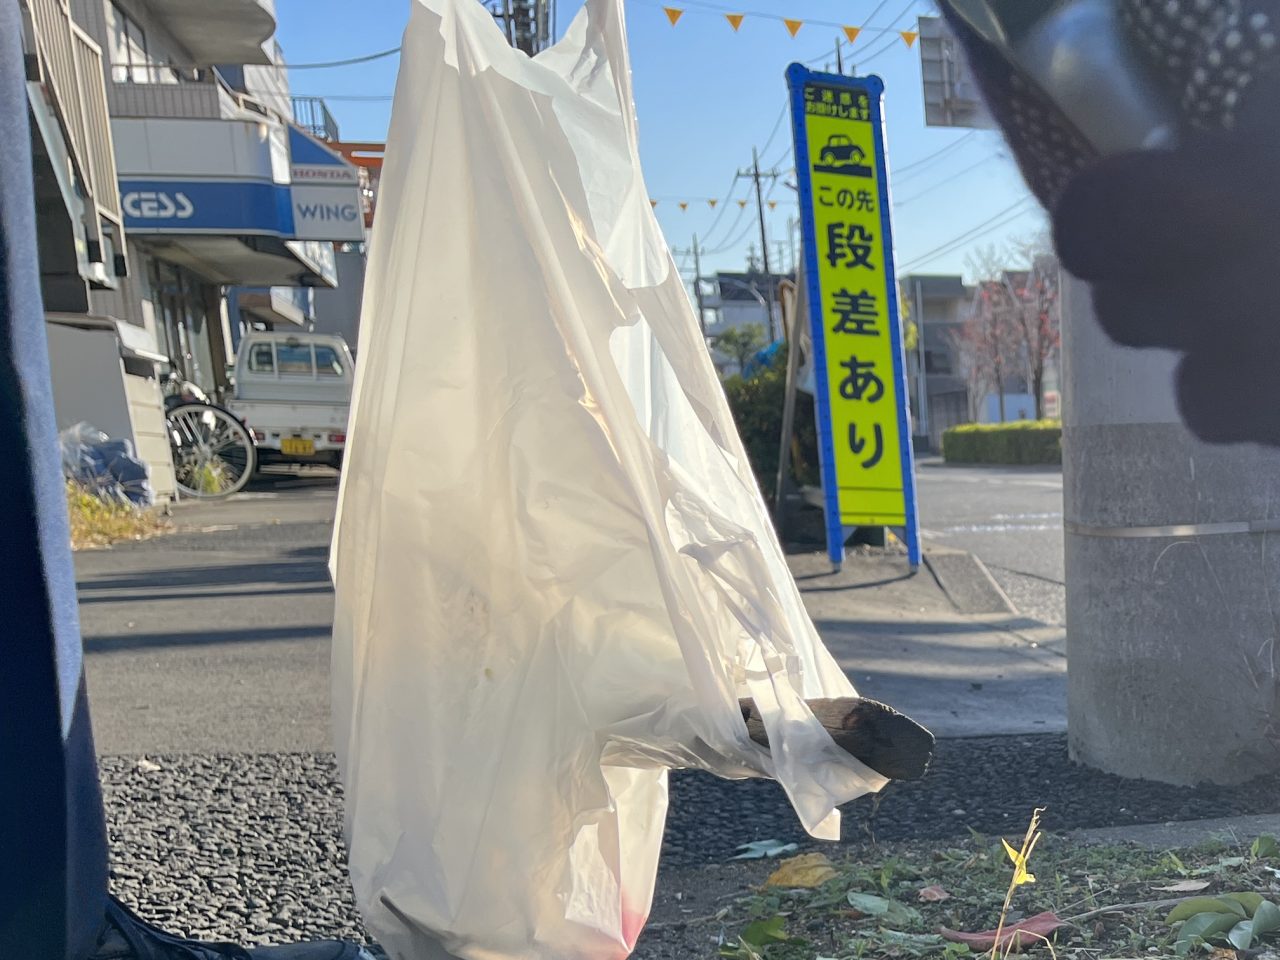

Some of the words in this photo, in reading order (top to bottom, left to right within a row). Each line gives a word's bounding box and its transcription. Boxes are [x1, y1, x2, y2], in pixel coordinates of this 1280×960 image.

[293, 168, 352, 179] HONDA
[119, 191, 195, 219] CESS
[296, 203, 357, 222] WING
[819, 186, 875, 213] この先
[826, 221, 885, 469] 段差あり
